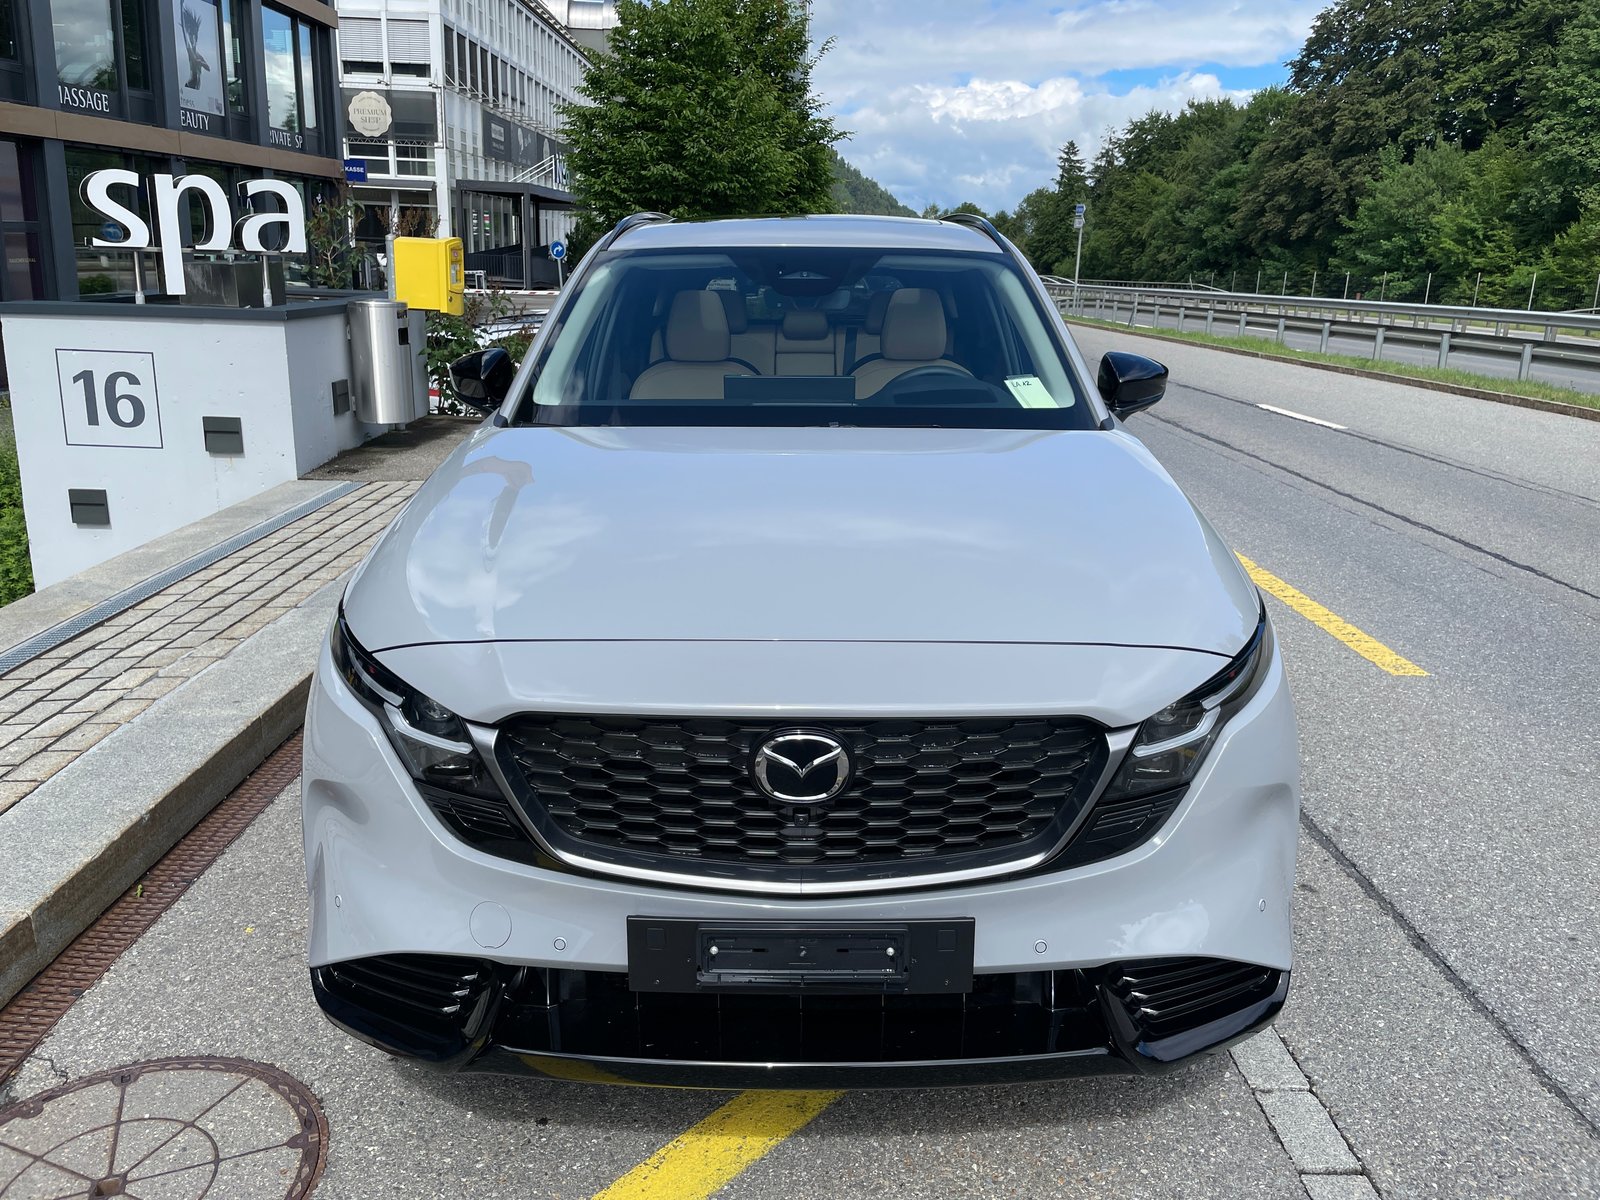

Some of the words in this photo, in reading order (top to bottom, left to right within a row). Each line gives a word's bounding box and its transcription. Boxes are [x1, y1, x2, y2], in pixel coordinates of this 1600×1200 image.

[180, 110, 209, 130] EAUTY
[353, 107, 387, 116] PREMIUM
[294, 134, 303, 149] SP
[80, 168, 306, 295] spa
[72, 369, 146, 428] 16
